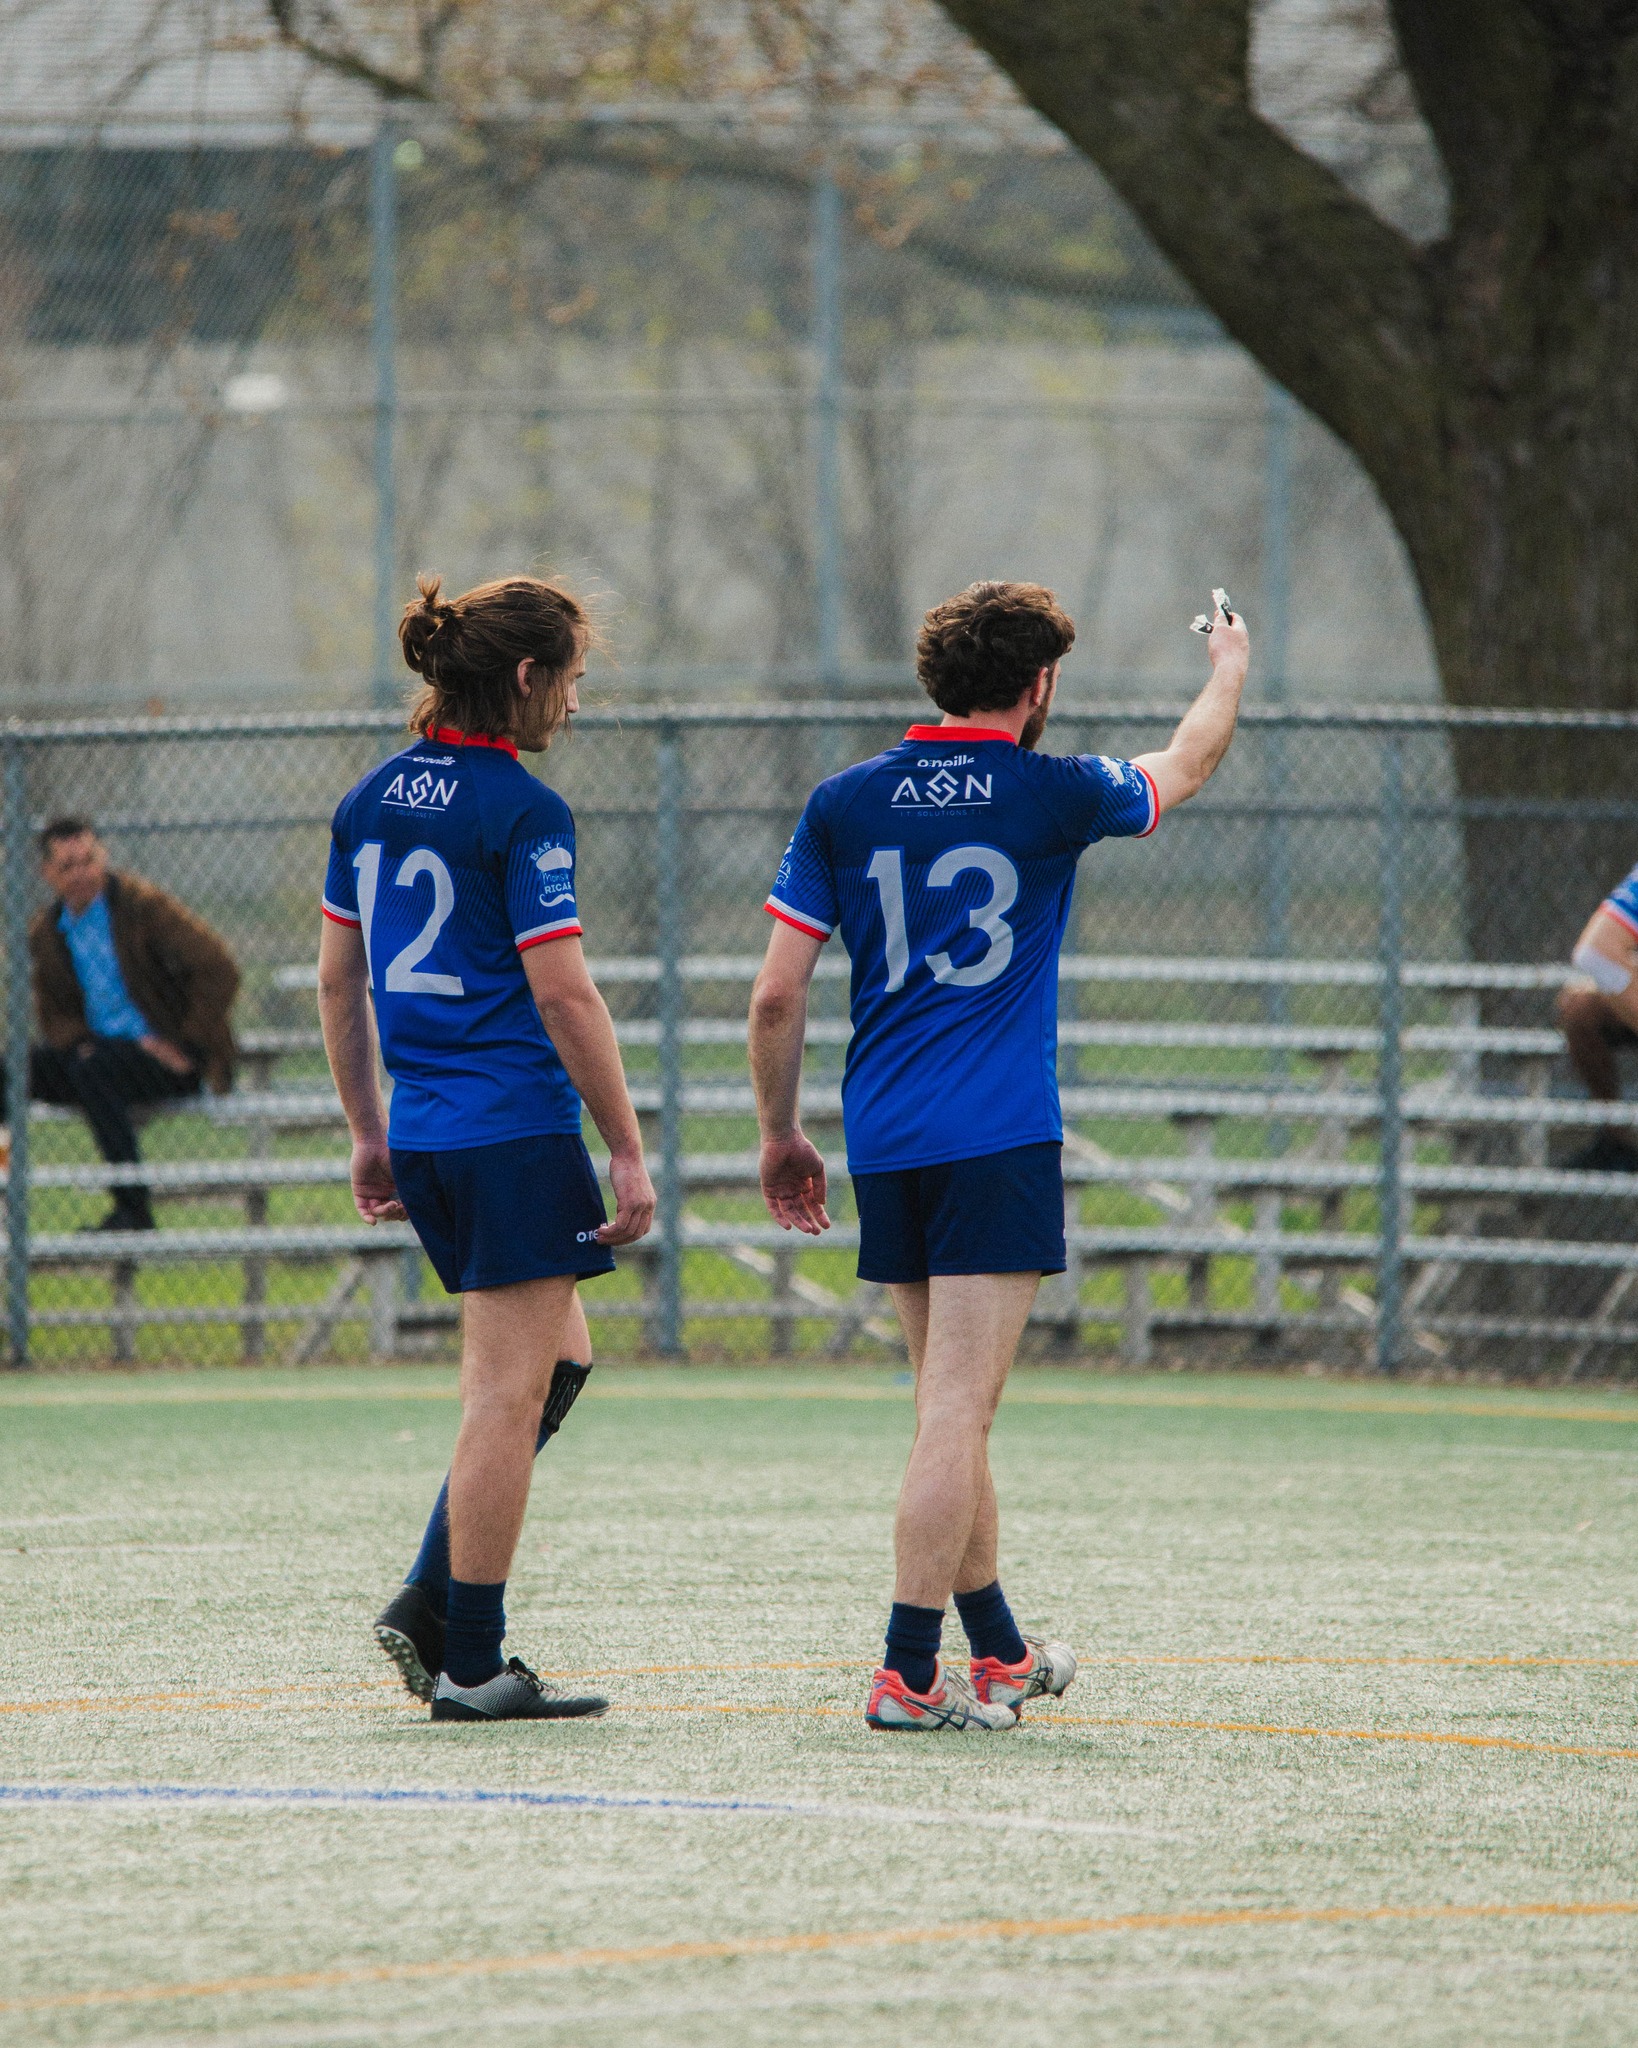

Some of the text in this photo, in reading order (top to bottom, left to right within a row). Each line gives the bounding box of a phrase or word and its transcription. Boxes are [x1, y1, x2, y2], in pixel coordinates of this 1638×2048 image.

[383, 769, 459, 808] ASN
[890, 768, 993, 808] ASN
[917, 809, 968, 817] SOLUTIONS
[530, 841, 552, 861] BAR
[352, 842, 465, 996] 12
[866, 845, 1019, 993] 13
